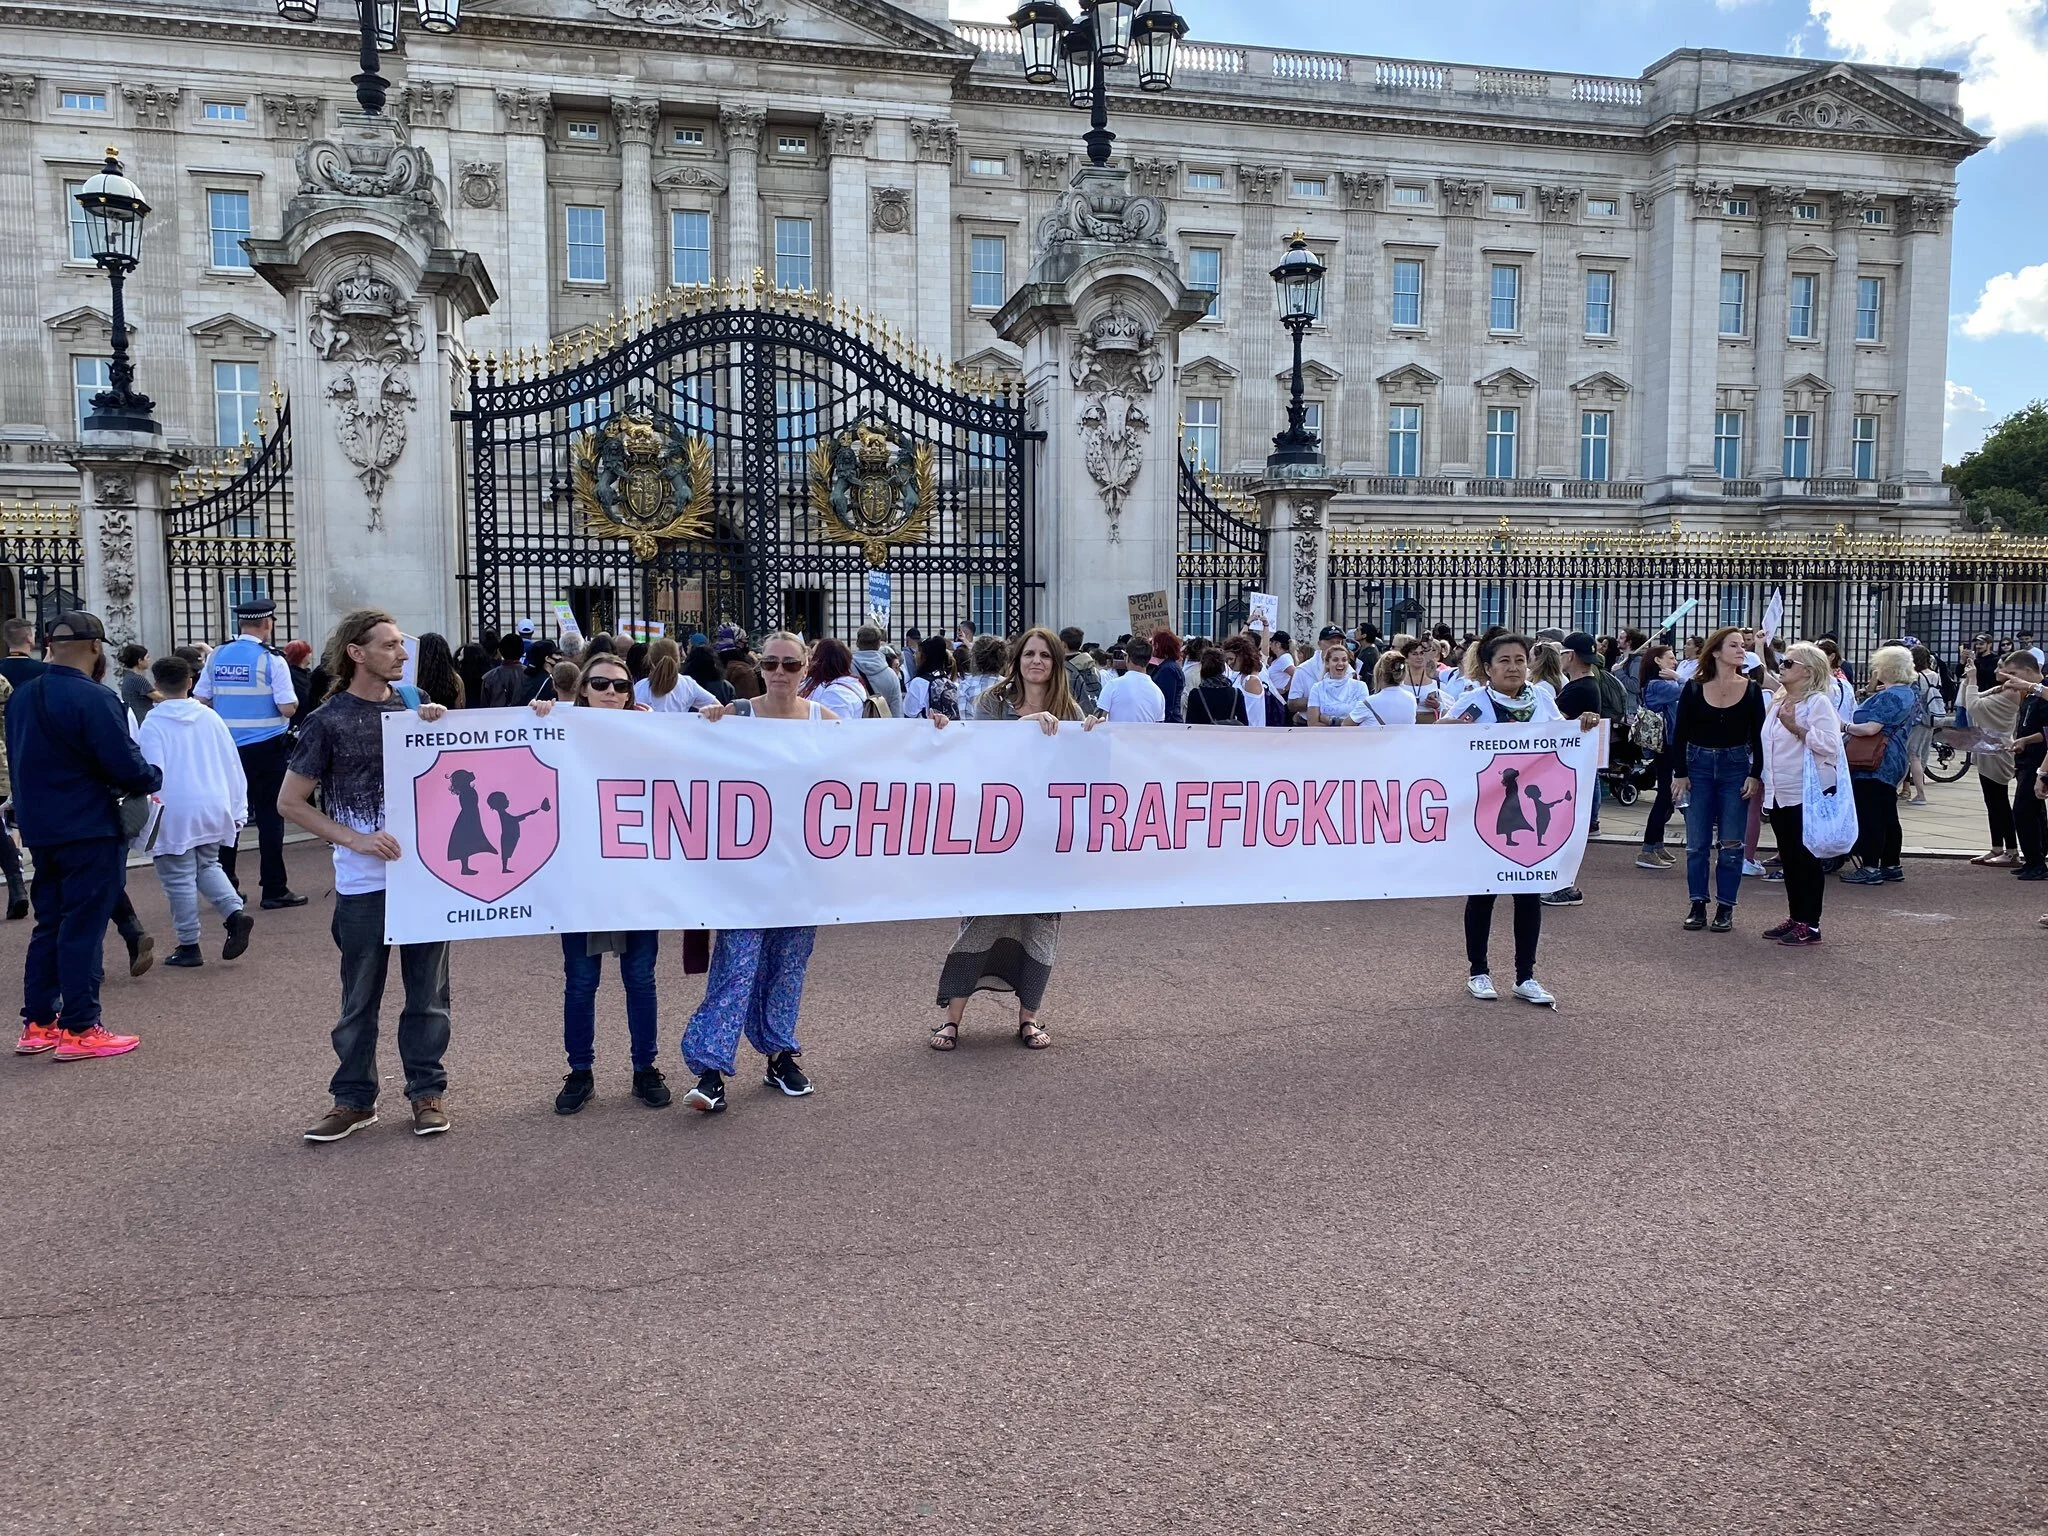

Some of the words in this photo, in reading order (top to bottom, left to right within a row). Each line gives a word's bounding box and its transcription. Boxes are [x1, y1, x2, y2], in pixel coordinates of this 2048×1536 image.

[1129, 593, 1154, 605] STOP
[1138, 598, 1163, 611] Child
[215, 666, 249, 675] POLICE
[405, 731, 489, 748] FREEDOM
[494, 728, 529, 743] FOR
[532, 727, 566, 741] THE
[1469, 740, 1530, 751] FREEDOM
[1533, 738, 1558, 749] FOR
[1560, 737, 1581, 748] THE
[597, 779, 773, 861] END
[804, 779, 1024, 860] CHILD
[1048, 778, 1449, 853] TRAFFICKING
[1496, 870, 1558, 882] CHILDREN
[446, 904, 532, 924] CHILDREN
